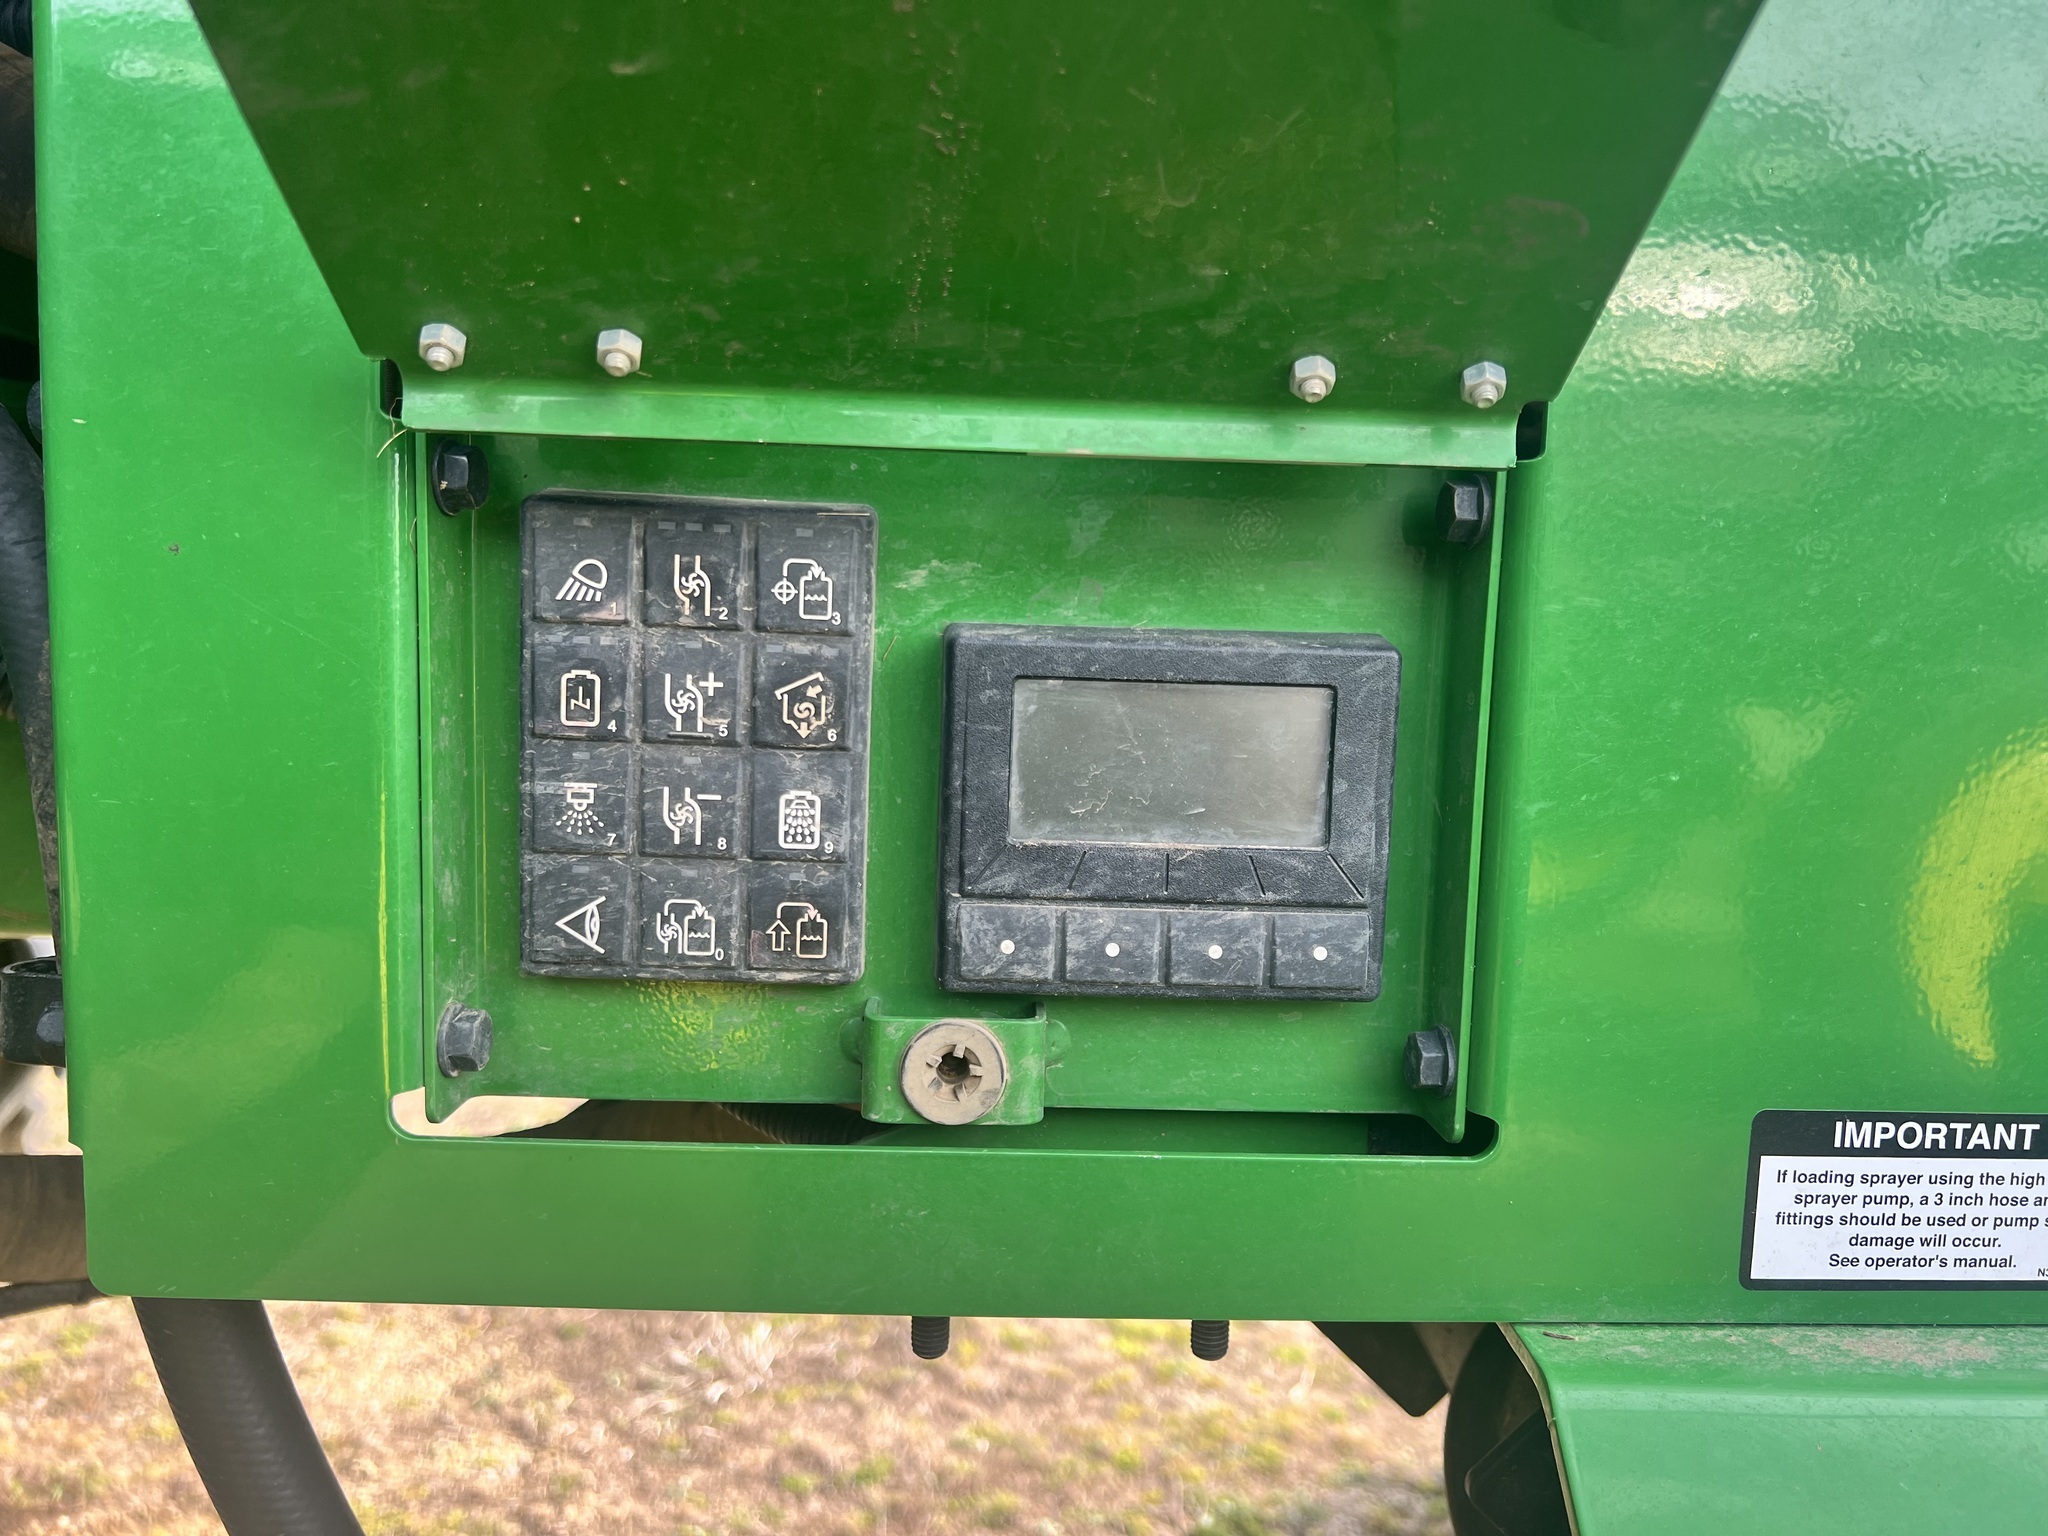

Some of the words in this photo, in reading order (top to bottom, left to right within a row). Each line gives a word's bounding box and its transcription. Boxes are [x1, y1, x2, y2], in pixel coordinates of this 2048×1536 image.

[609, 603, 618, 617] 1
[718, 606, 729, 621] 2
[830, 612, 842, 626] 3
[606, 718, 618, 733] 4
[718, 723, 729, 738] 5
[826, 728, 838, 743] 6
[606, 832, 617, 845] 7
[716, 836, 727, 851] 8
[824, 840, 835, 855] 9
[713, 947, 725, 962] 0
[1834, 1121, 2040, 1150] IMPORTANT
[1777, 1170, 1787, 1183] If
[1793, 1170, 1854, 1187] loading
[1860, 1174, 1923, 1188] sprayer
[1929, 1172, 1973, 1188] using
[1980, 1172, 2005, 1185] the
[2010, 1173, 2045, 1189] high
[1794, 1194, 1857, 1207] sprayer
[1863, 1195, 1913, 1209] pump,
[1920, 1196, 1928, 1205] a
[1934, 1193, 1943, 1205] 3
[1949, 1193, 1983, 1206] inch
[1990, 1193, 2028, 1206] hose
[1776, 1212, 1833, 1228] fittings
[1839, 1213, 1896, 1226] should
[1902, 1213, 1921, 1226] be
[1927, 1214, 1966, 1226] used
[1972, 1217, 1988, 1226] or
[1993, 1217, 2039, 1230] pump
[1849, 1234, 1914, 1250] damage
[1920, 1234, 1946, 1247] will
[1952, 1237, 2001, 1247] occur.
[1829, 1254, 1859, 1267] See
[1865, 1255, 1947, 1270] operator's
[1954, 1255, 2016, 1268] manual.
